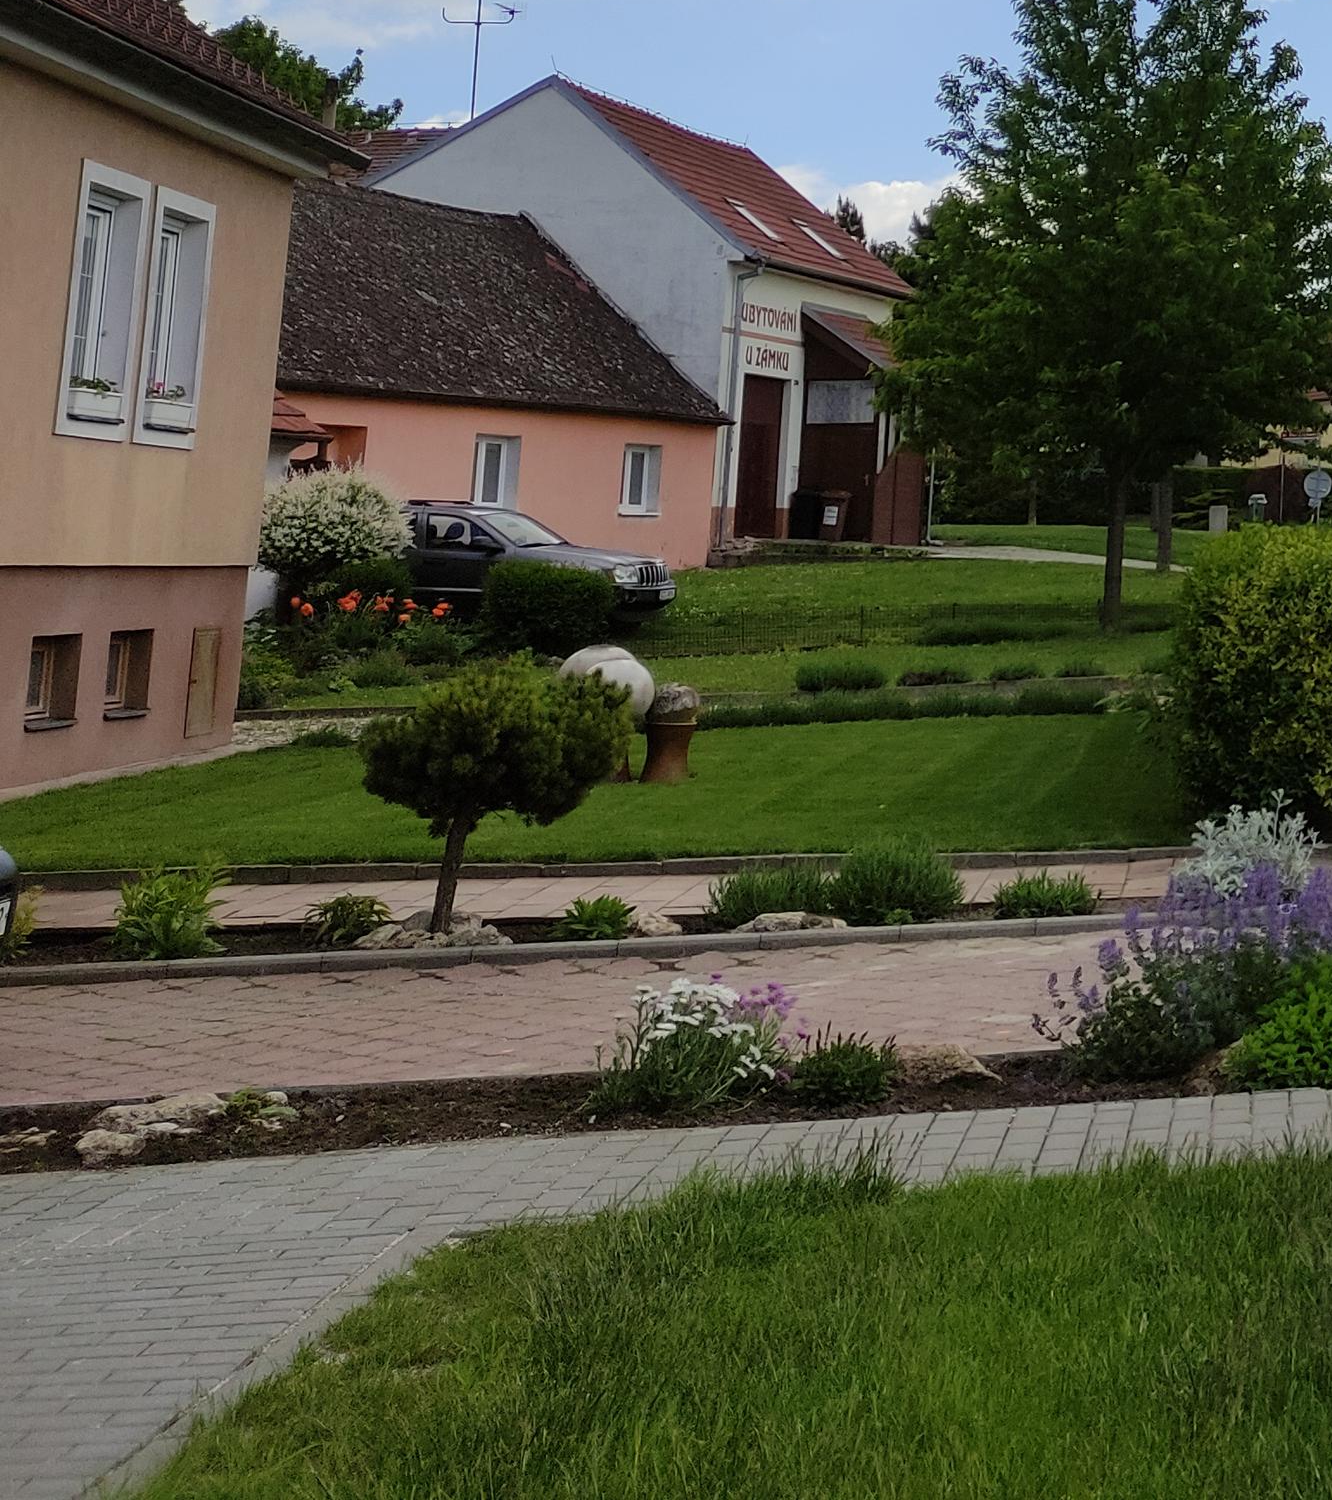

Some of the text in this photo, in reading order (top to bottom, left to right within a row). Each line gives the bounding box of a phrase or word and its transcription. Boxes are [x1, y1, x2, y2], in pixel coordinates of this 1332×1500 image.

[741, 301, 798, 333] UBYTOVÁNÍ
[745, 343, 790, 372] U ZÁMKU
